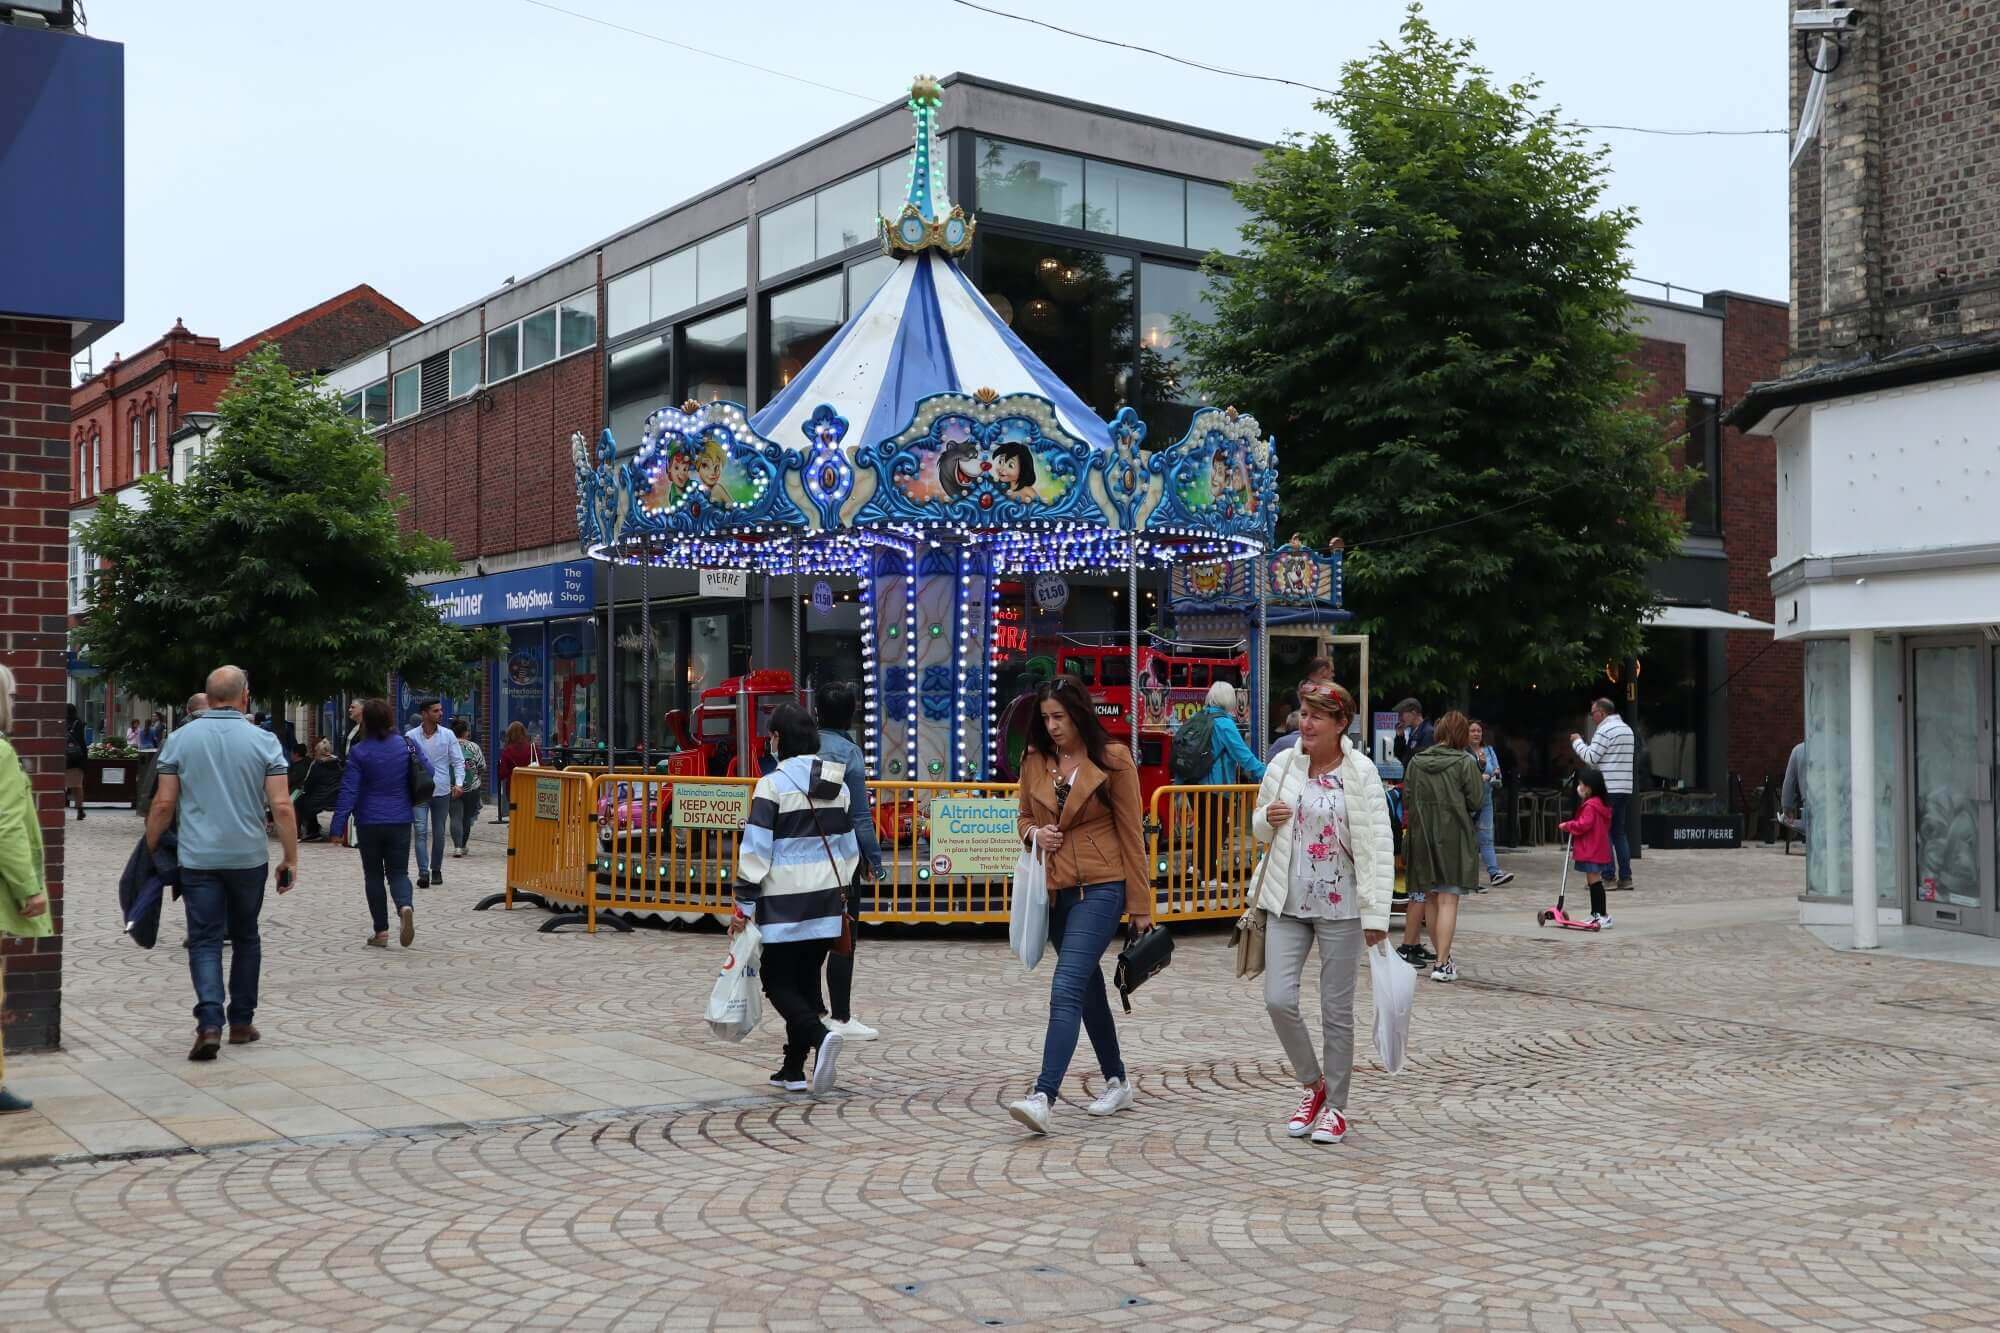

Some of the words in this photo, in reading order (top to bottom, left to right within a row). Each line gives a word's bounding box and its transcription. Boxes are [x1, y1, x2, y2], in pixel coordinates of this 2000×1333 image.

[564, 568, 582, 578] The
[706, 572, 740, 586] PIERRE
[565, 580, 581, 592] Toy
[560, 592, 585, 603] Shop
[1039, 584, 1065, 601] £1.50
[677, 787, 714, 797] Altrincham
[716, 789, 746, 798] Carousel
[679, 799, 707, 811] KEEP
[710, 800, 741, 812] YOUR
[683, 812, 737, 825] DISTANCE
[950, 819, 1014, 834] Carousel
[1673, 828, 1705, 840] BISTROT
[1708, 828, 1734, 840] PIERRE
[951, 846, 968, 854] place
